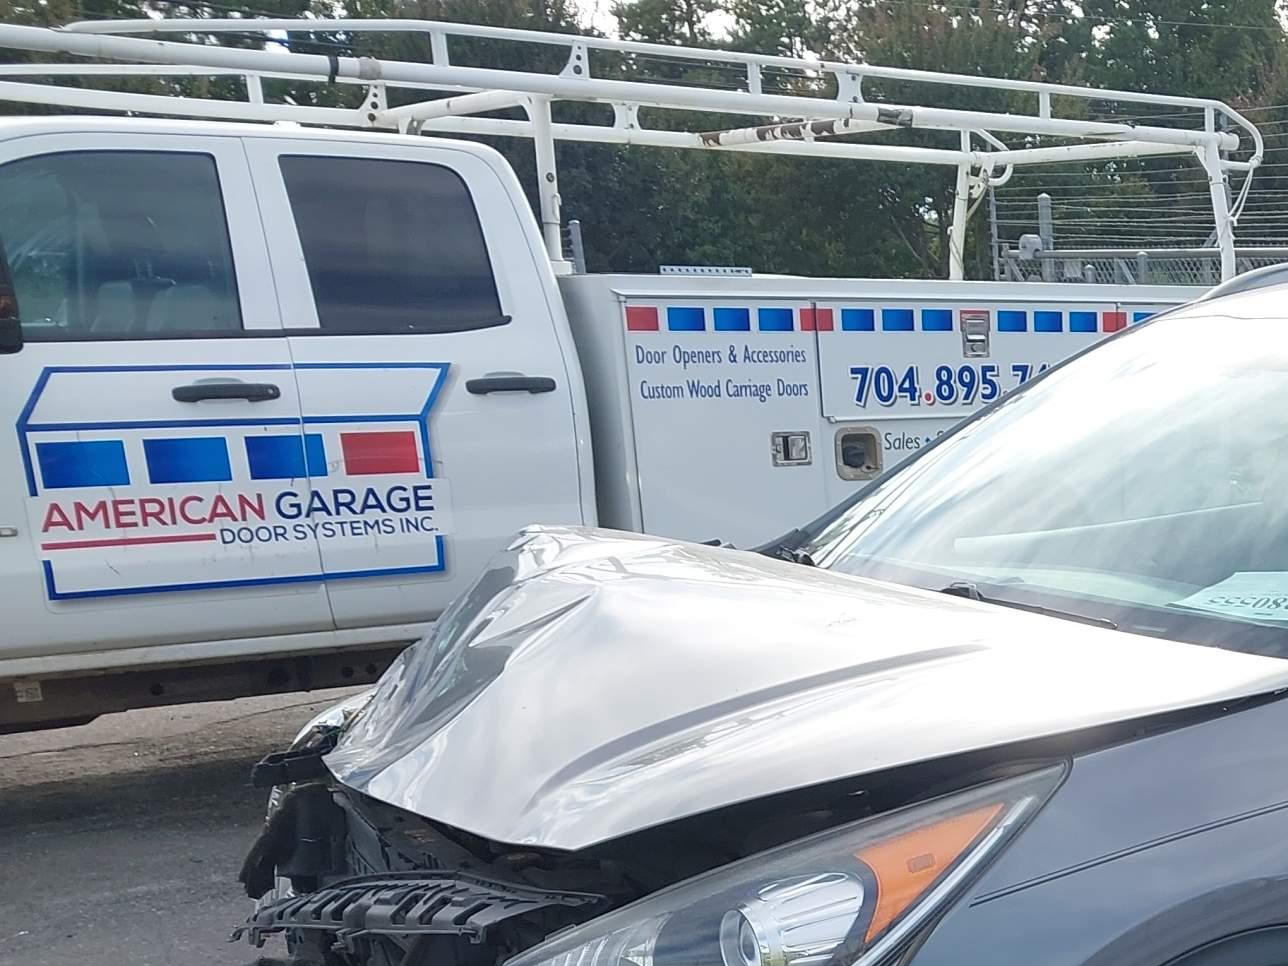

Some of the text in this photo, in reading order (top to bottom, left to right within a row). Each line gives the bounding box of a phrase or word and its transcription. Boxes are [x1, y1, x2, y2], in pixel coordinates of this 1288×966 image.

[635, 344, 806, 370] Door Openers & Accessories
[640, 378, 808, 403] Custom Wood Carriage Doors
[850, 363, 1050, 408] 704.895.7
[884, 431, 921, 450] Sales
[41, 484, 435, 533] AMERICAN GARAGE
[220, 516, 439, 545] DOOR SYSTEMS INC.
